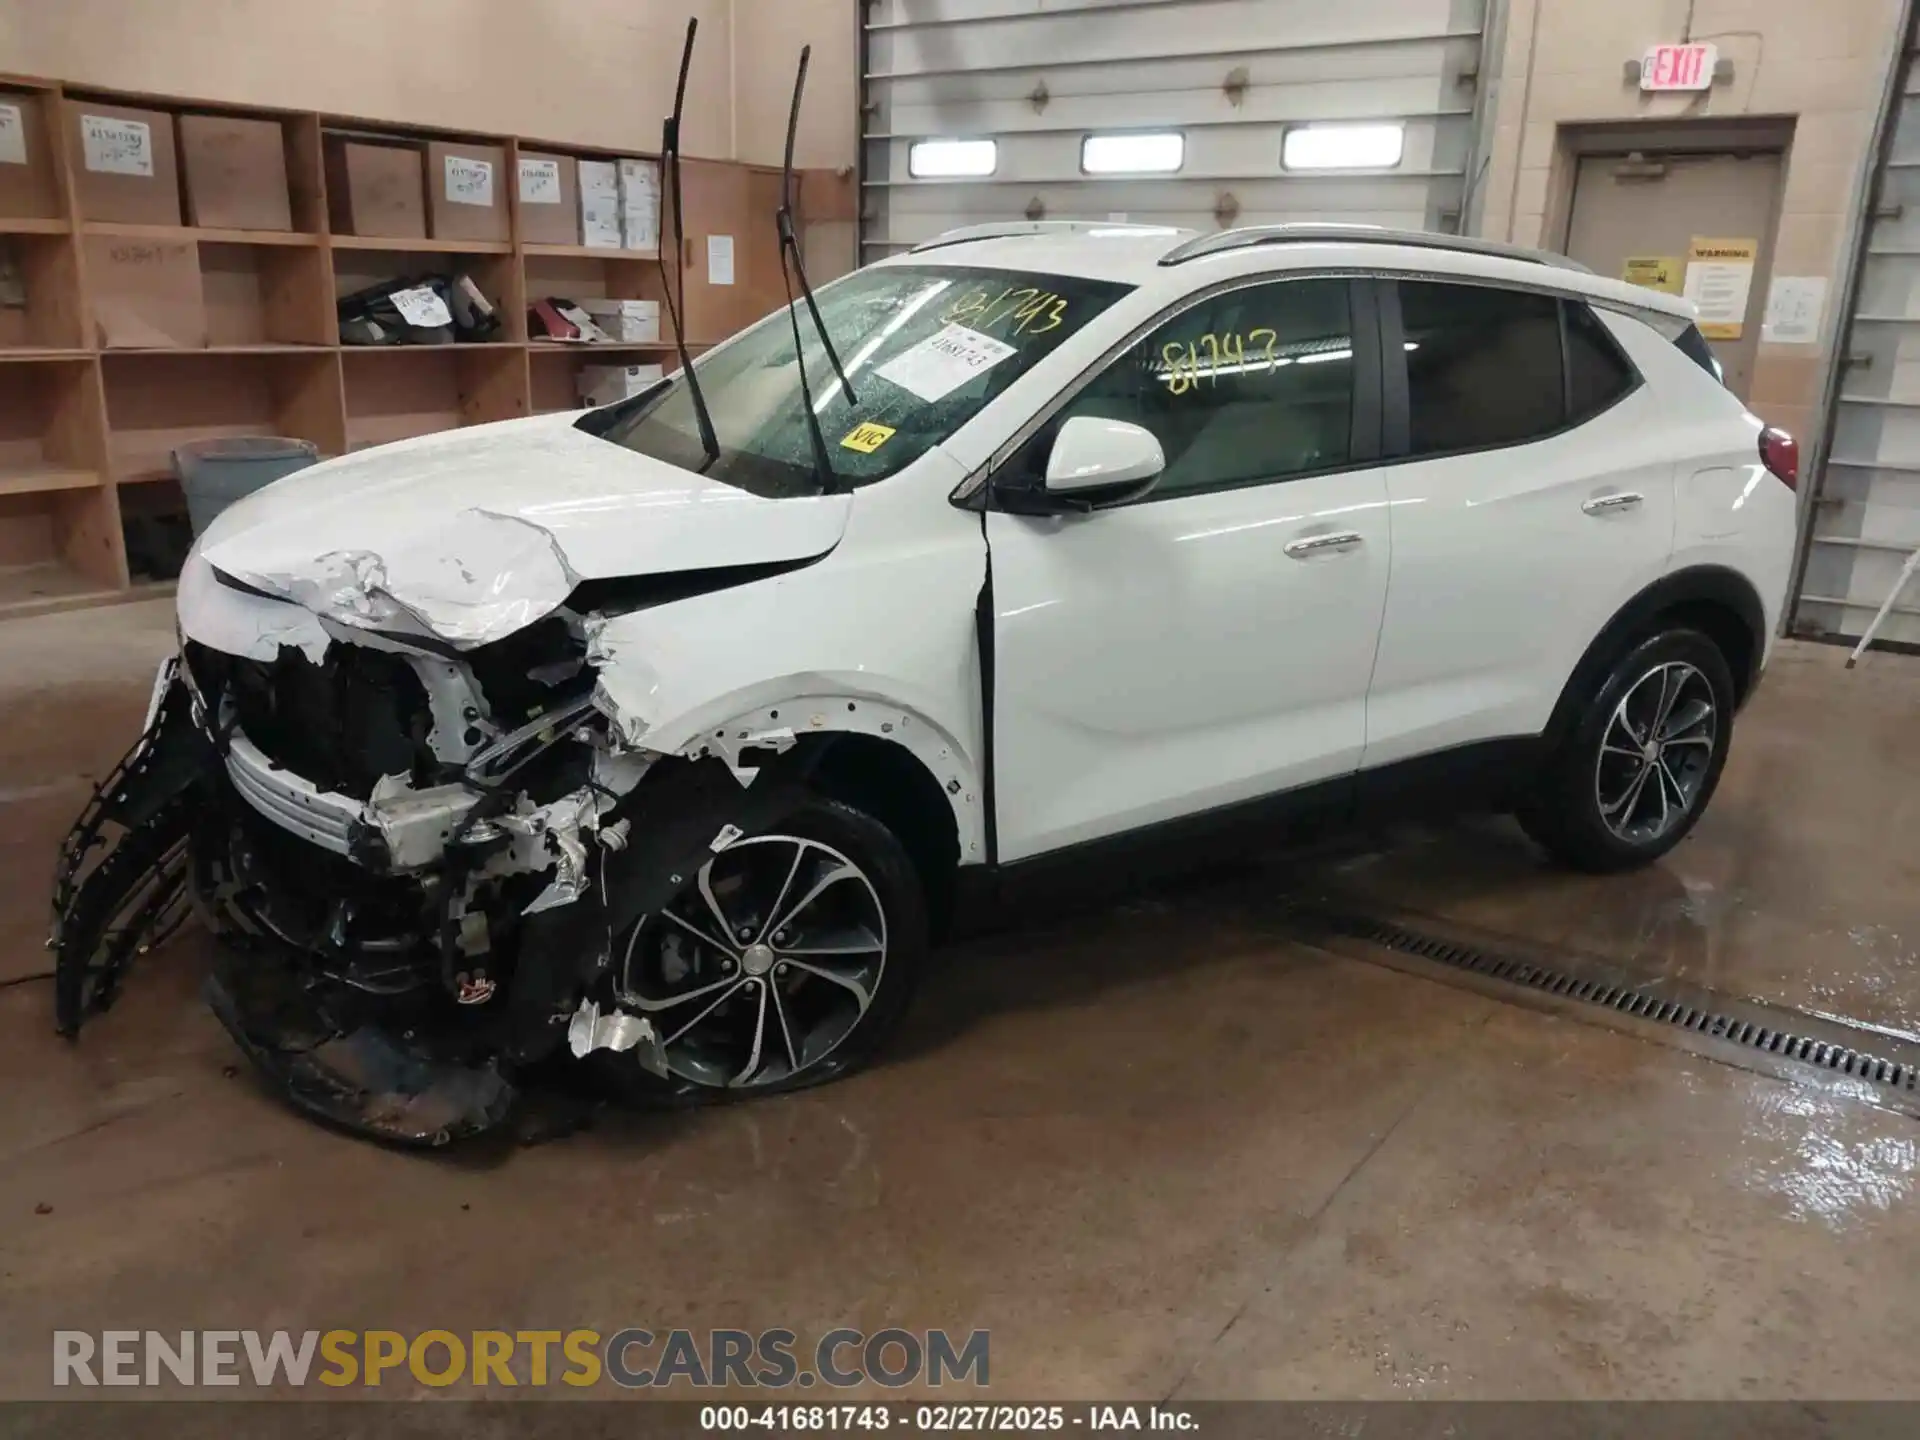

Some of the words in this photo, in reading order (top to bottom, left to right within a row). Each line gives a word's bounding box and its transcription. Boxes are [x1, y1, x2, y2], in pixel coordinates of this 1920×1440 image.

[1653, 47, 1706, 85] EXIT
[1695, 248, 1751, 258] WARNING
[852, 428, 885, 445] VIC
